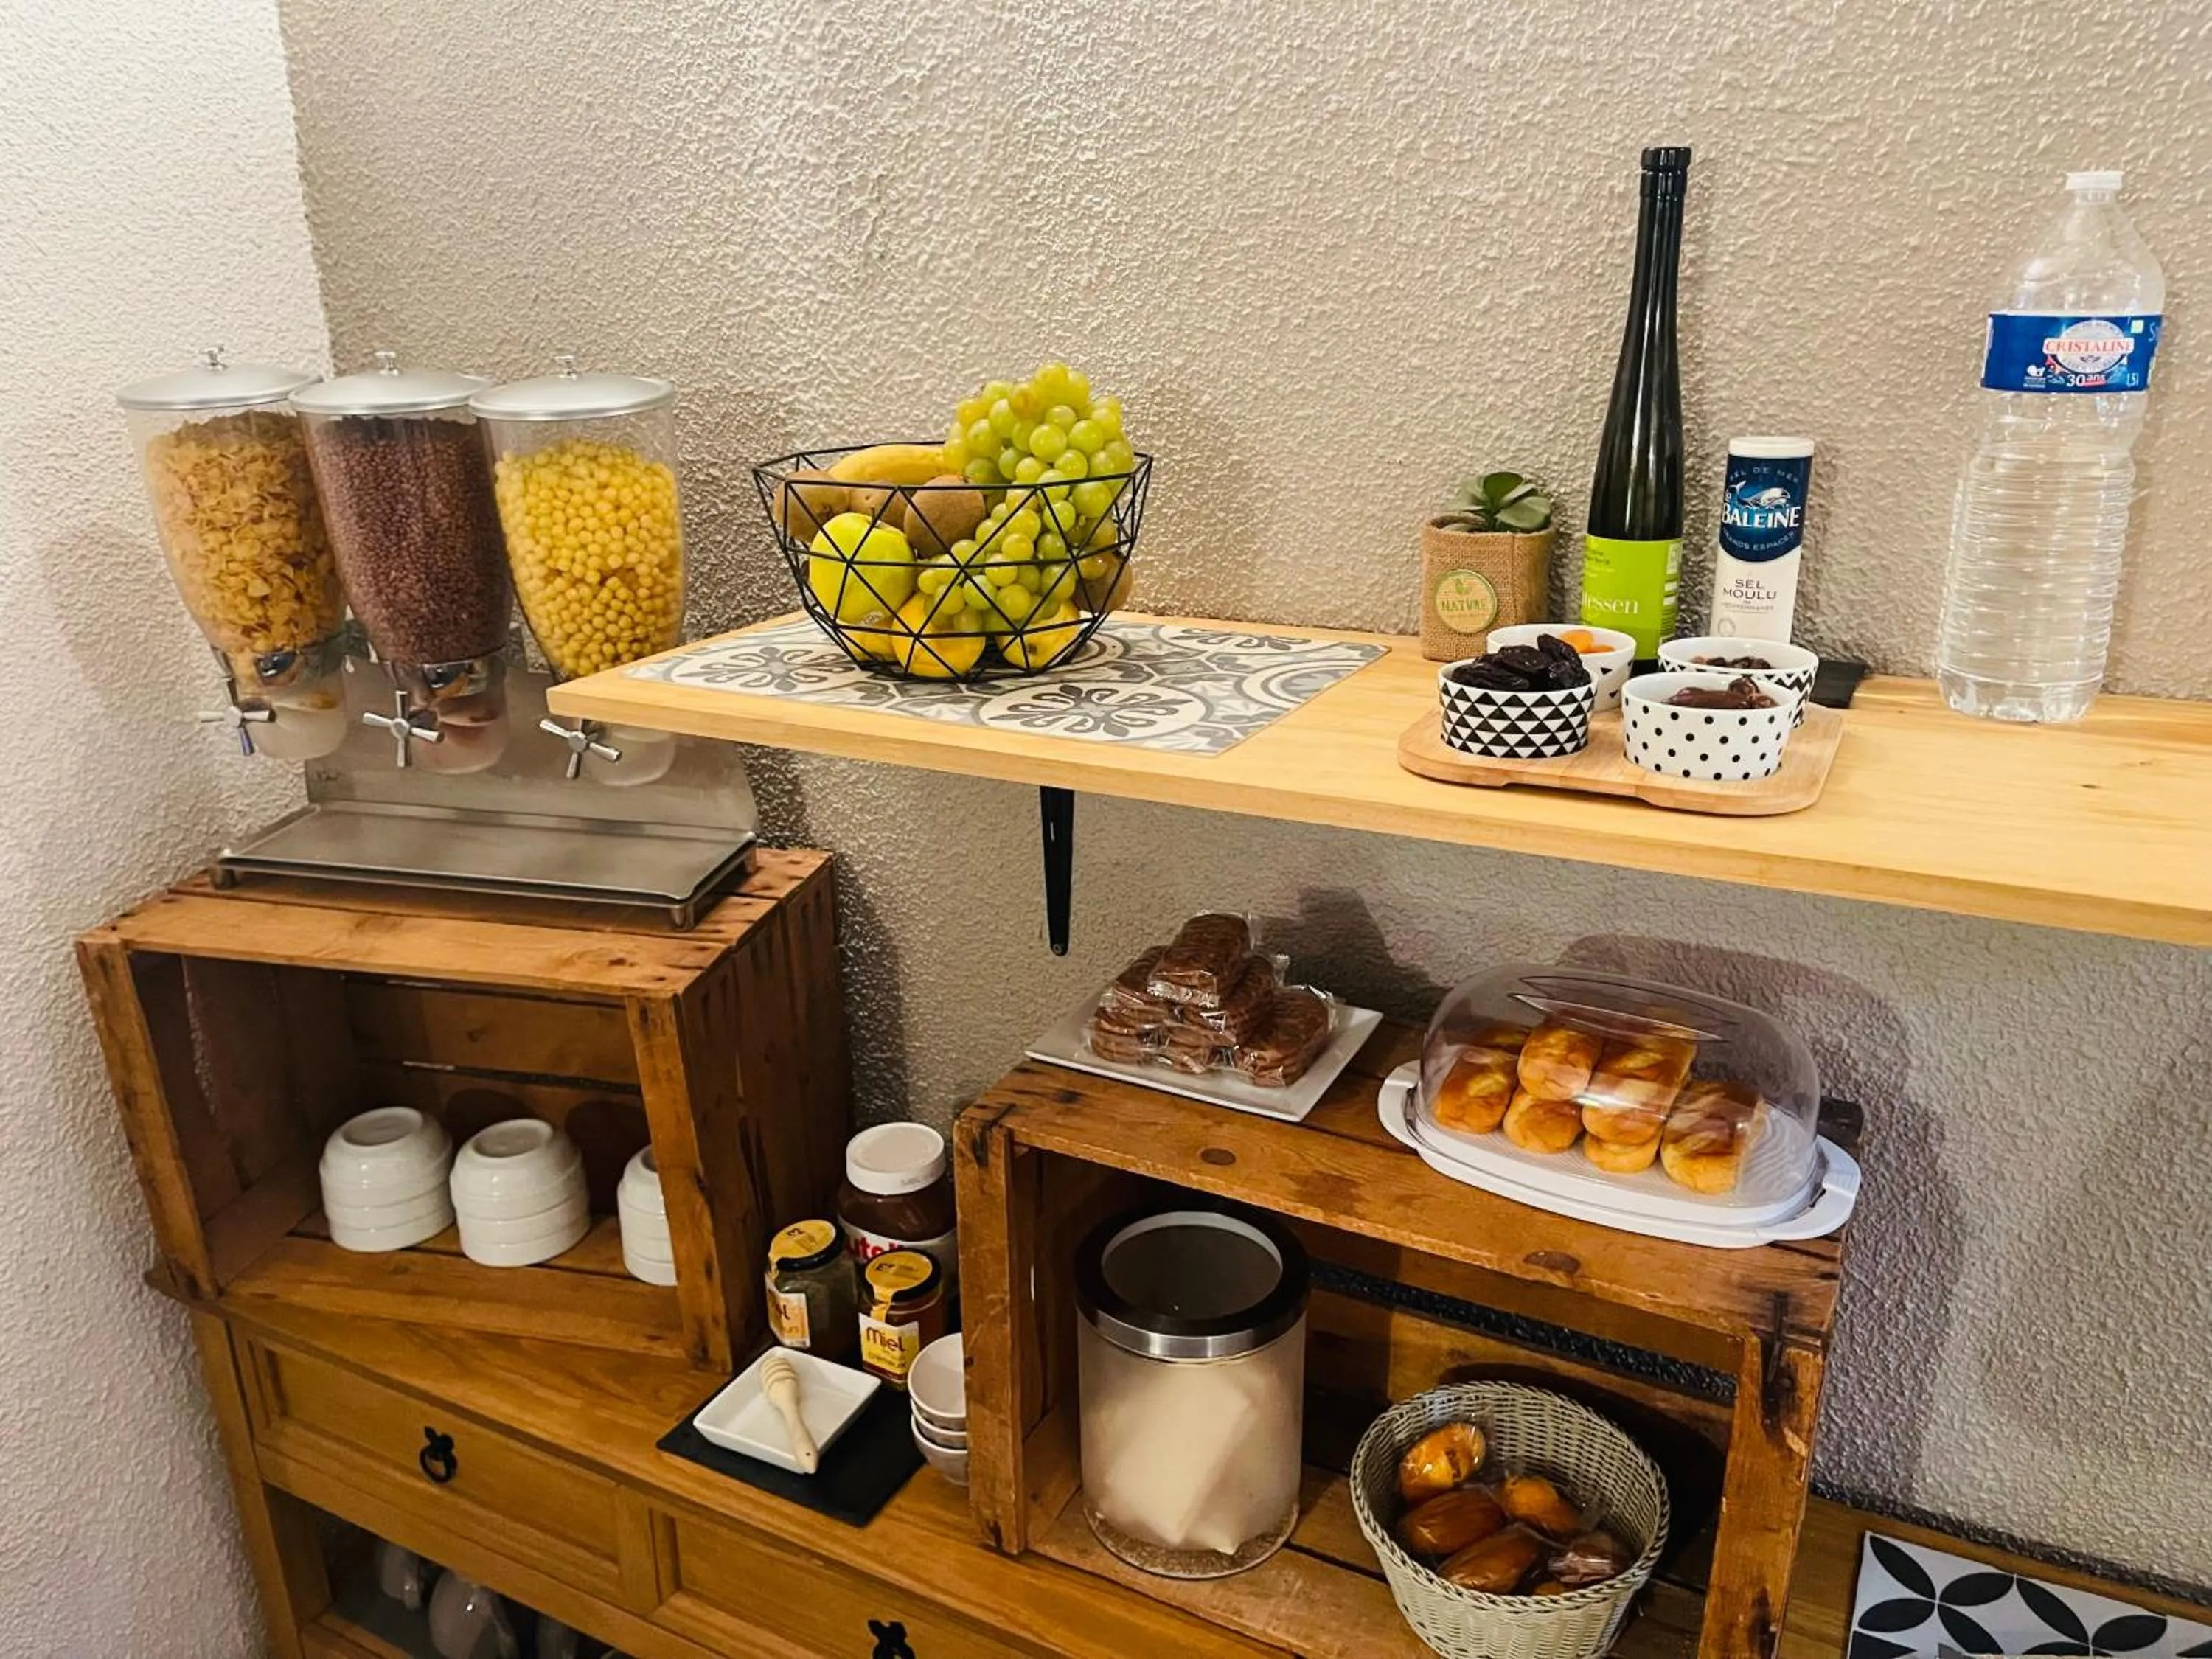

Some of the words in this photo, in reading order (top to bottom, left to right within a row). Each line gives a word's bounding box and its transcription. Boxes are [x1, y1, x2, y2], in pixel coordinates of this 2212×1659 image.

[2066, 374, 2086, 387] 30
[1722, 502, 1801, 529] BALEINE
[1734, 578, 1765, 590] SEL
[1722, 587, 1778, 599] MOULU
